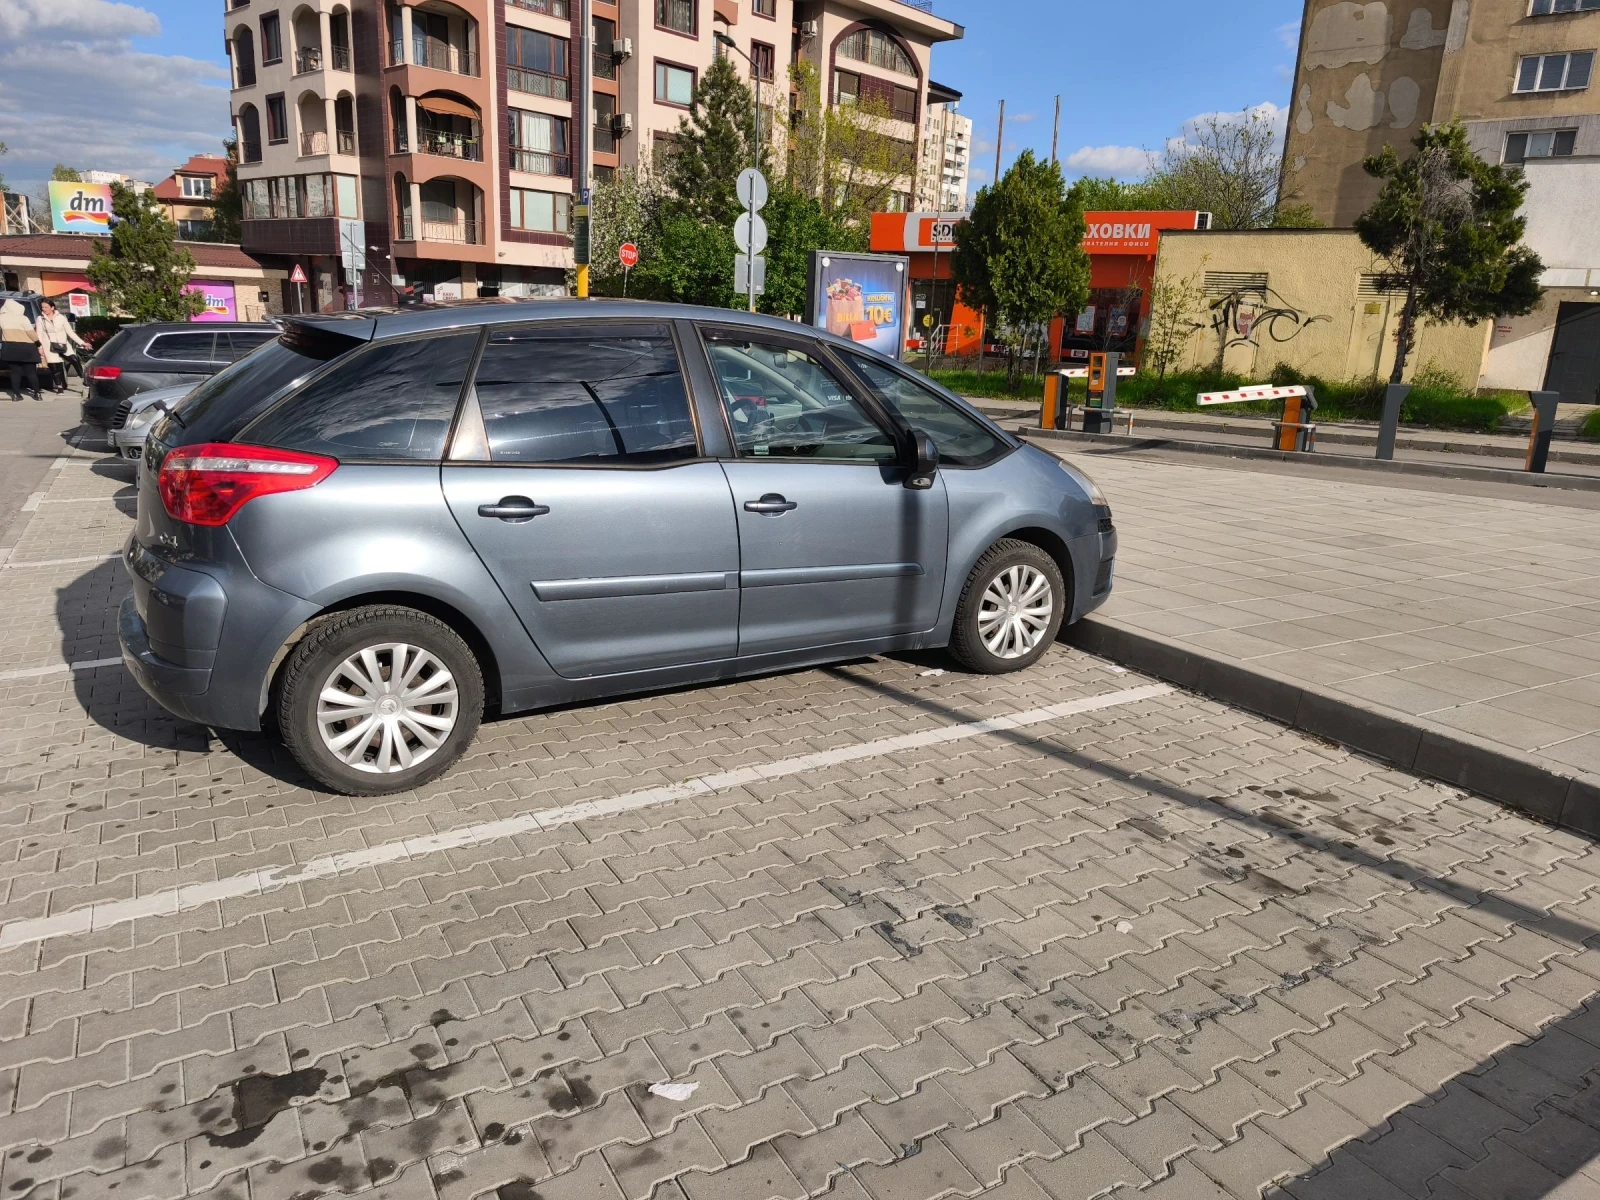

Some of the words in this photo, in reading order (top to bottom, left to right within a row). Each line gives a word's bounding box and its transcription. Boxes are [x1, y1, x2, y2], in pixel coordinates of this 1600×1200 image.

[70, 190, 104, 212] dm
[582, 191, 588, 202] P
[1083, 223, 1151, 239] ХОВКИ
[621, 249, 636, 260] STOP
[205, 295, 224, 307] dm
[837, 312, 859, 323] BILLA
[865, 306, 893, 325] 10€
